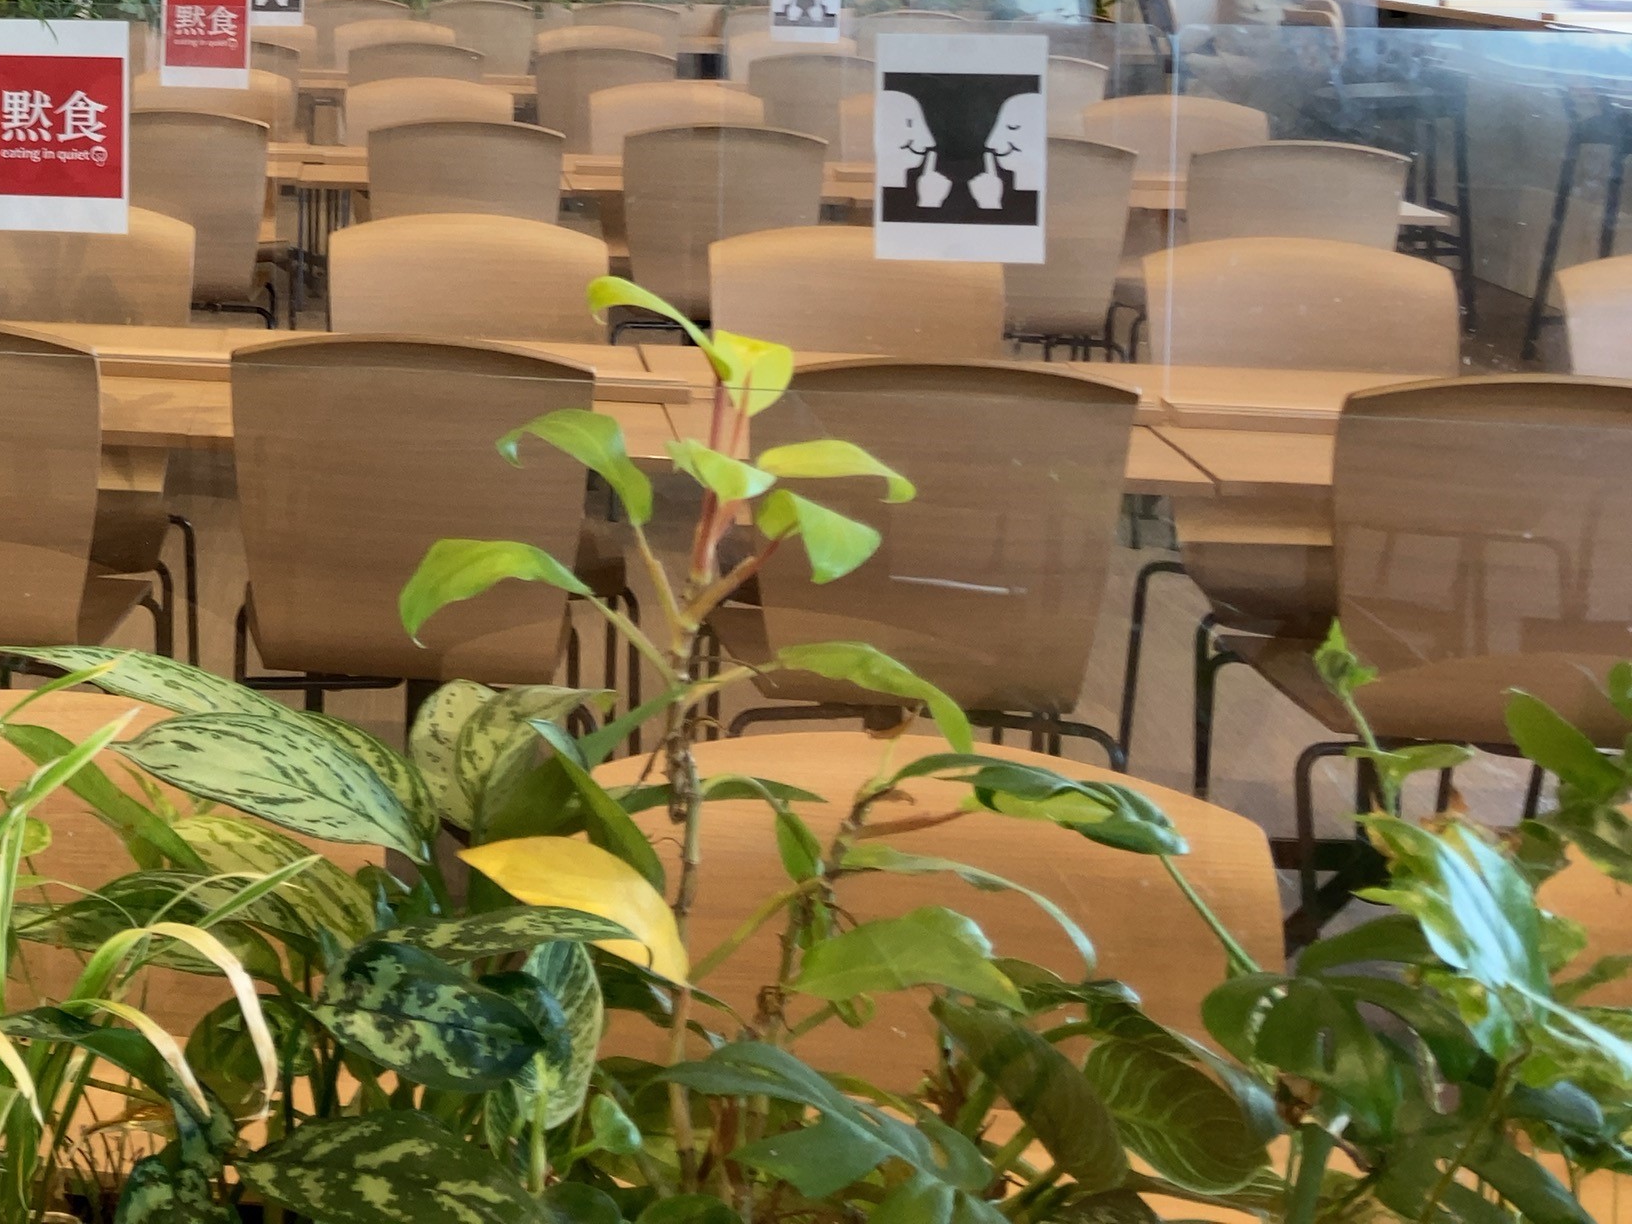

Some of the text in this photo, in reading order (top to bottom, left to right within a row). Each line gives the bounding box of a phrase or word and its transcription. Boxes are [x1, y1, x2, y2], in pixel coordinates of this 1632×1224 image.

[0, 89, 108, 143] 黙食
[0, 147, 90, 163] eating in quiet
